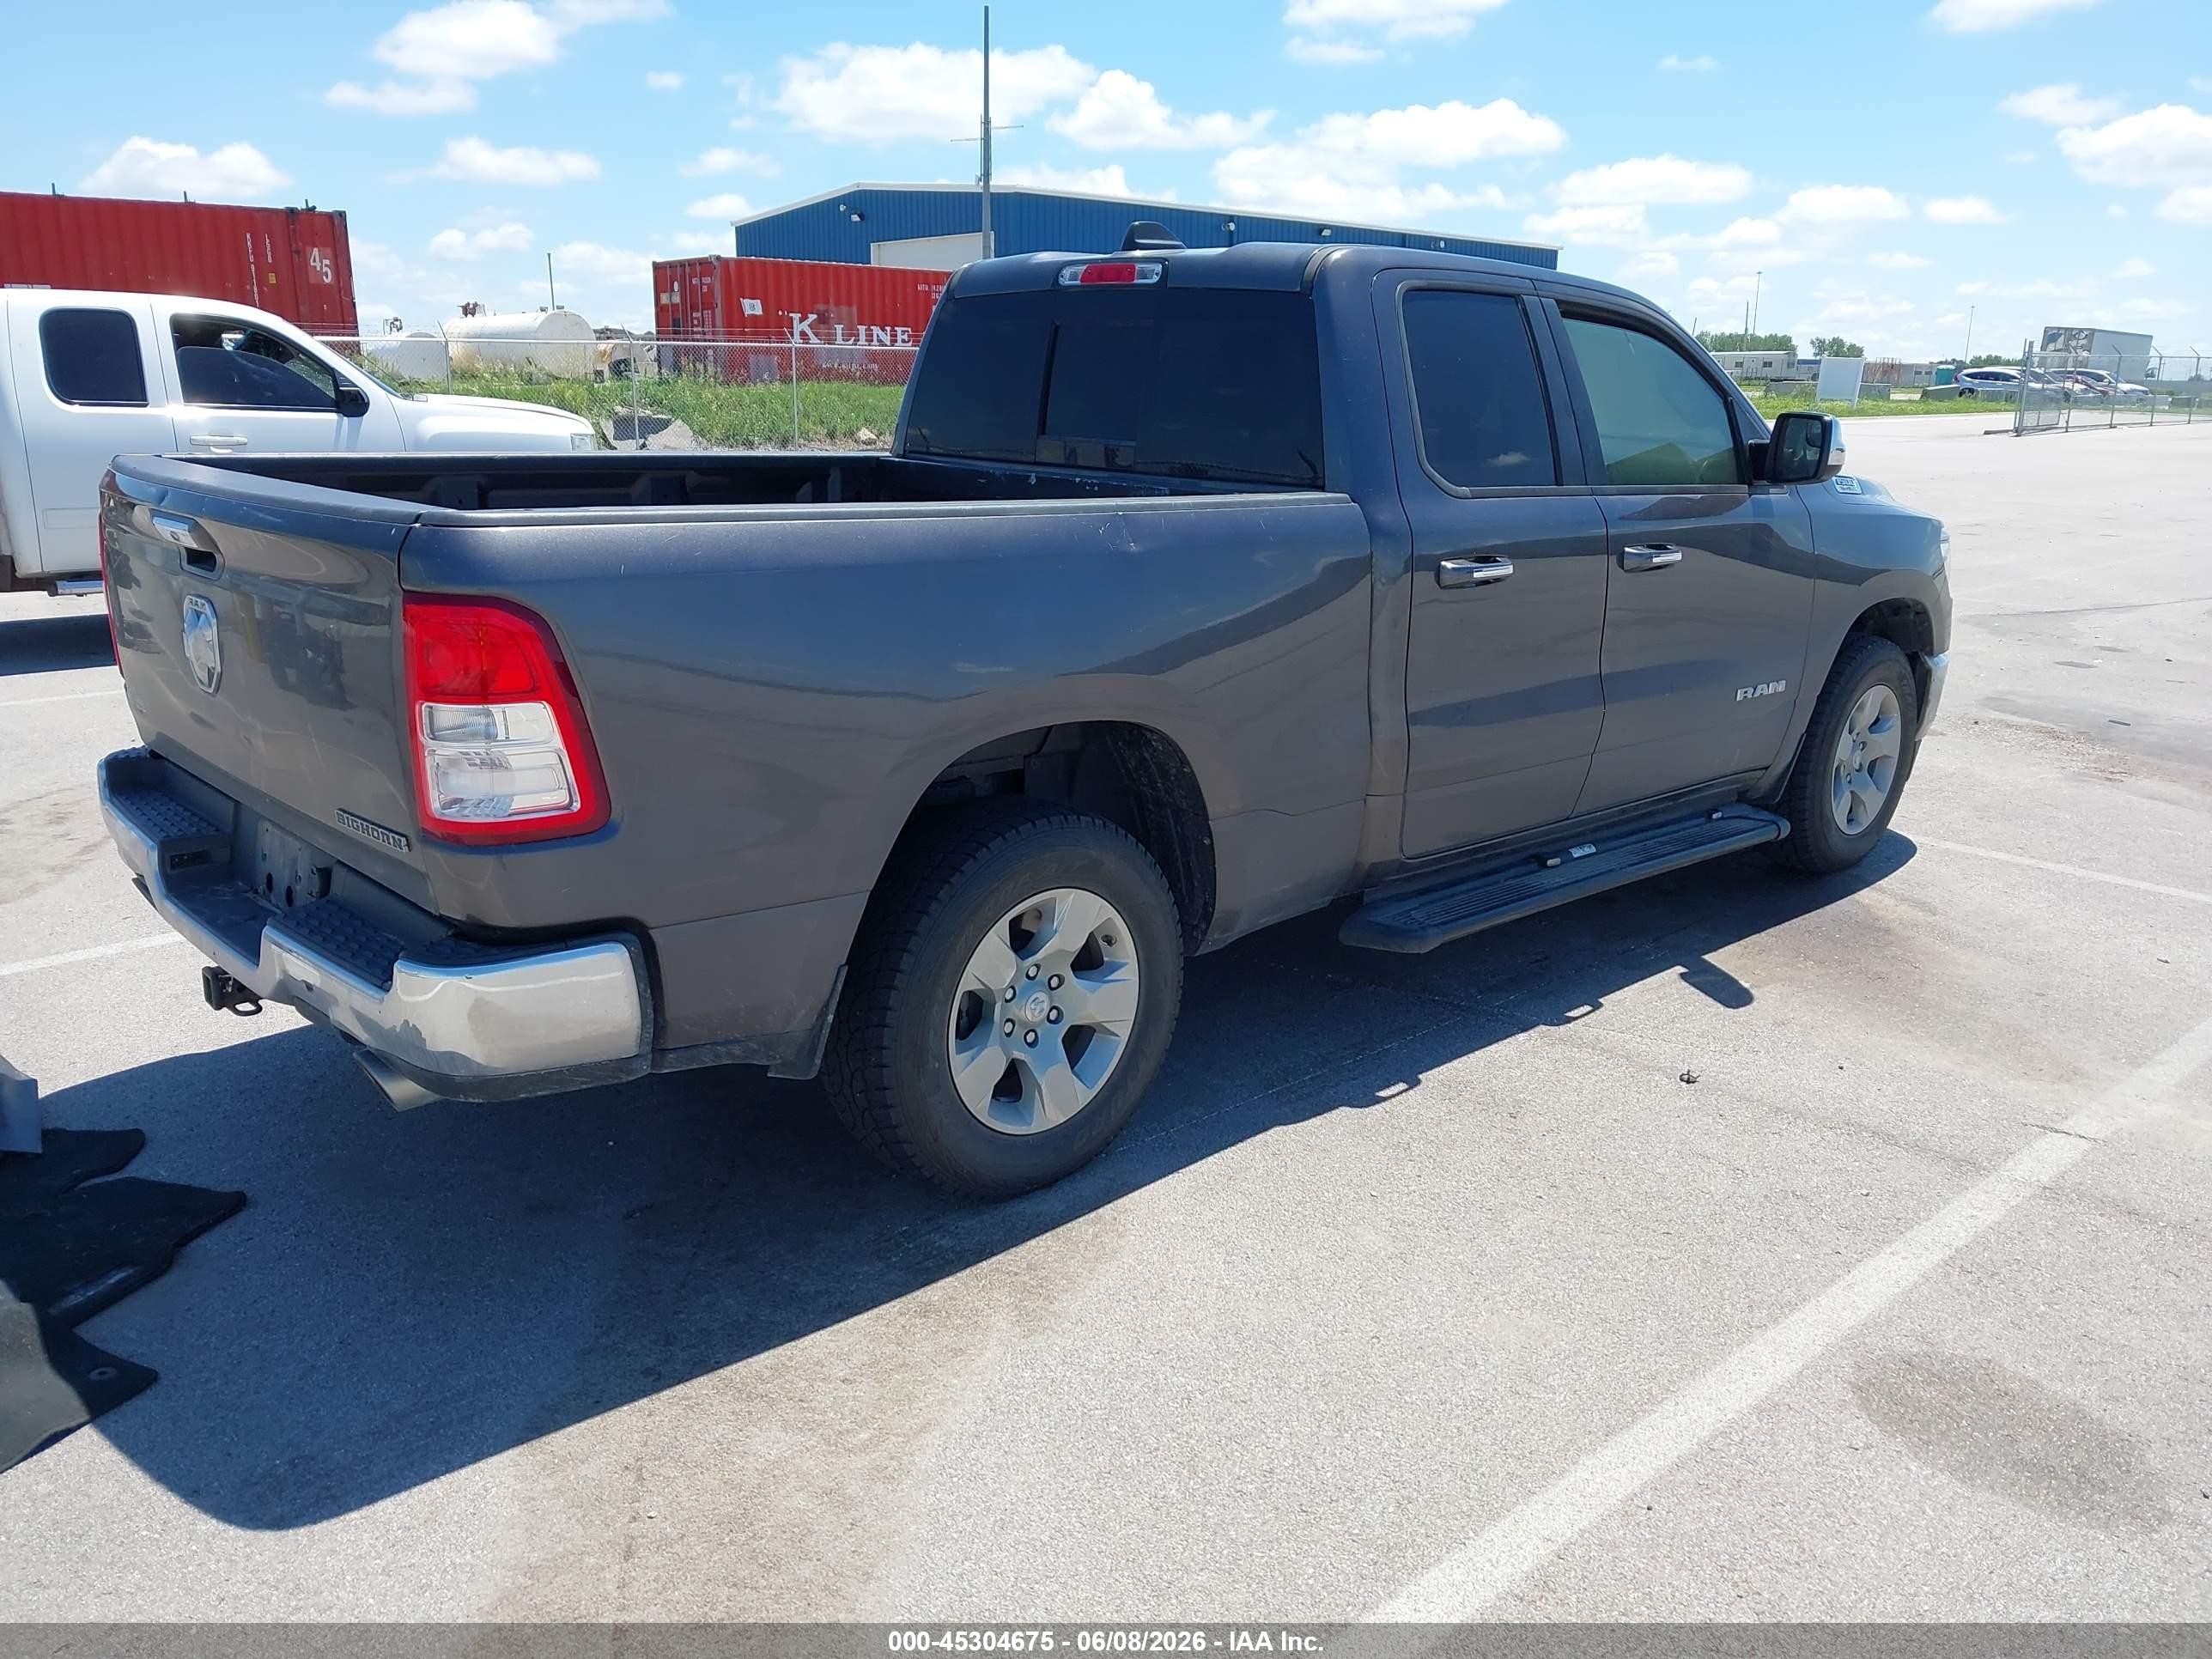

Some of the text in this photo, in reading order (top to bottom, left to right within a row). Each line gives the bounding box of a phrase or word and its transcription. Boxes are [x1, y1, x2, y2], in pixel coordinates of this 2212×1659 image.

[310, 246, 332, 283] 45
[834, 324, 913, 346] LINE
[188, 597, 207, 611] RAM
[1735, 679, 1786, 702] RAM
[334, 810, 410, 853] BIGHORN
